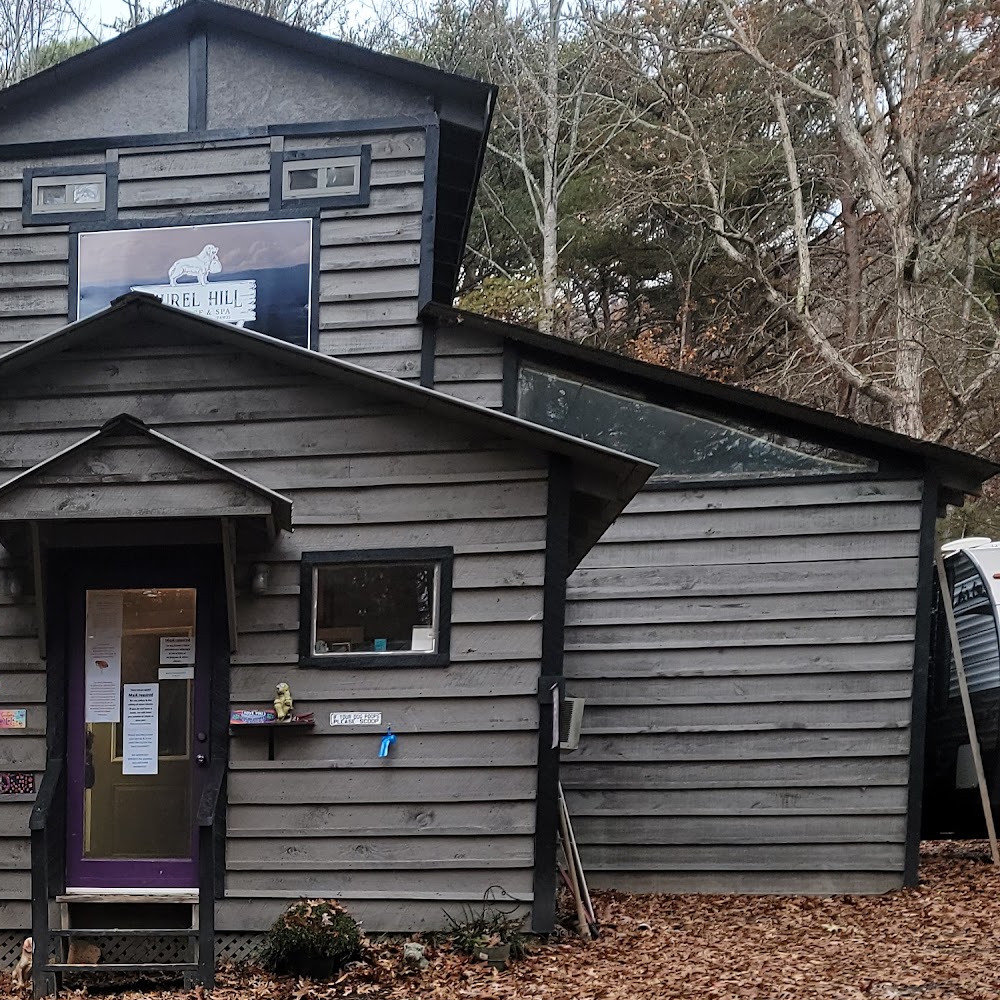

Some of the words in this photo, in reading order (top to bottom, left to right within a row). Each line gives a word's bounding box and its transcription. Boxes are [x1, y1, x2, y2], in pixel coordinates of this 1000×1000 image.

[161, 292, 200, 308] UREL
[208, 289, 242, 308] HILL
[215, 308, 231, 316] SPA
